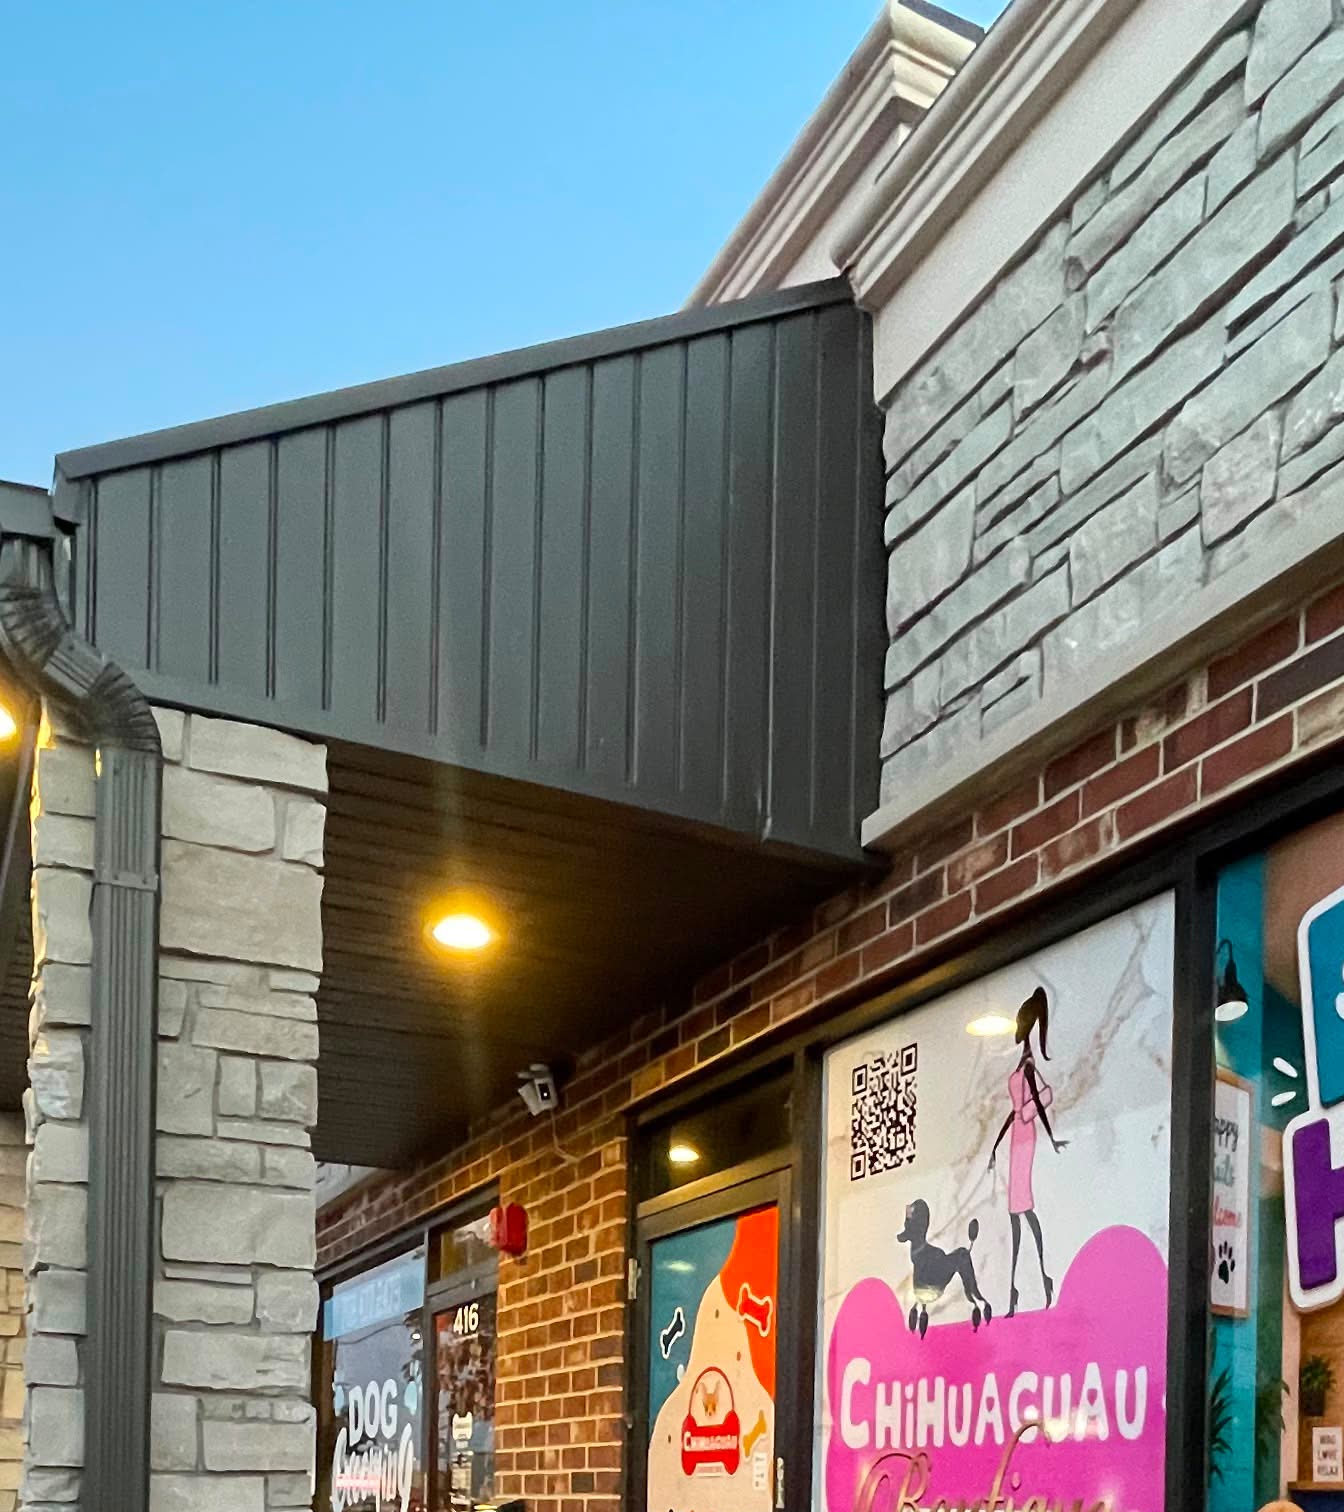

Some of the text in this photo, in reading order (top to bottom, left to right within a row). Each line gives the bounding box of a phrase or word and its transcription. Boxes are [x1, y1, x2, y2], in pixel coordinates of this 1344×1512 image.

[1214, 1118, 1239, 1152] appy
[453, 1303, 479, 1336] 416
[348, 1378, 398, 1447] DOG
